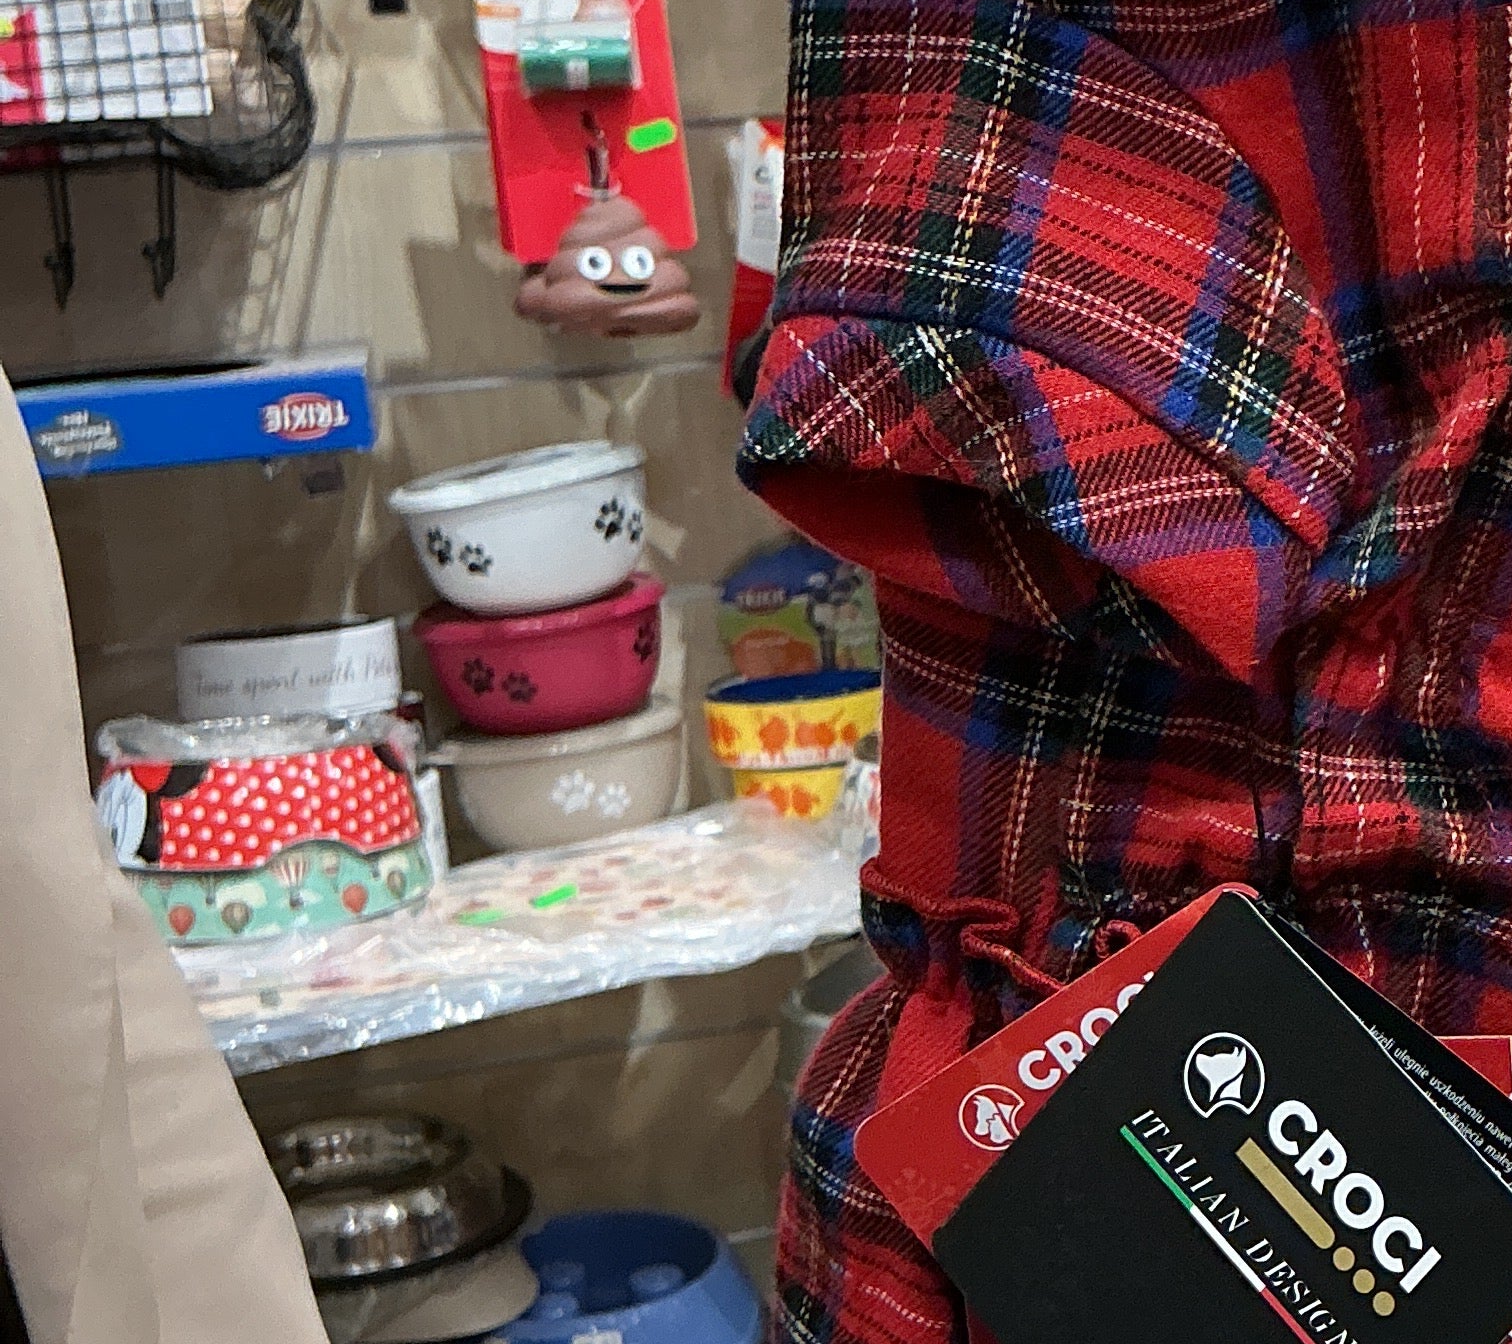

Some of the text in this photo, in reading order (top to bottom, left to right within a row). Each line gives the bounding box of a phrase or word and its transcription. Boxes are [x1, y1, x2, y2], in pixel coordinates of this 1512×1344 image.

[260, 398, 350, 434] TRIXIE
[1394, 1046, 1430, 1080] ulegnie
[1429, 1076, 1487, 1126] uszkodzeniu
[1131, 1108, 1251, 1235] ITALIAN
[1267, 1099, 1442, 1294] CROCI
